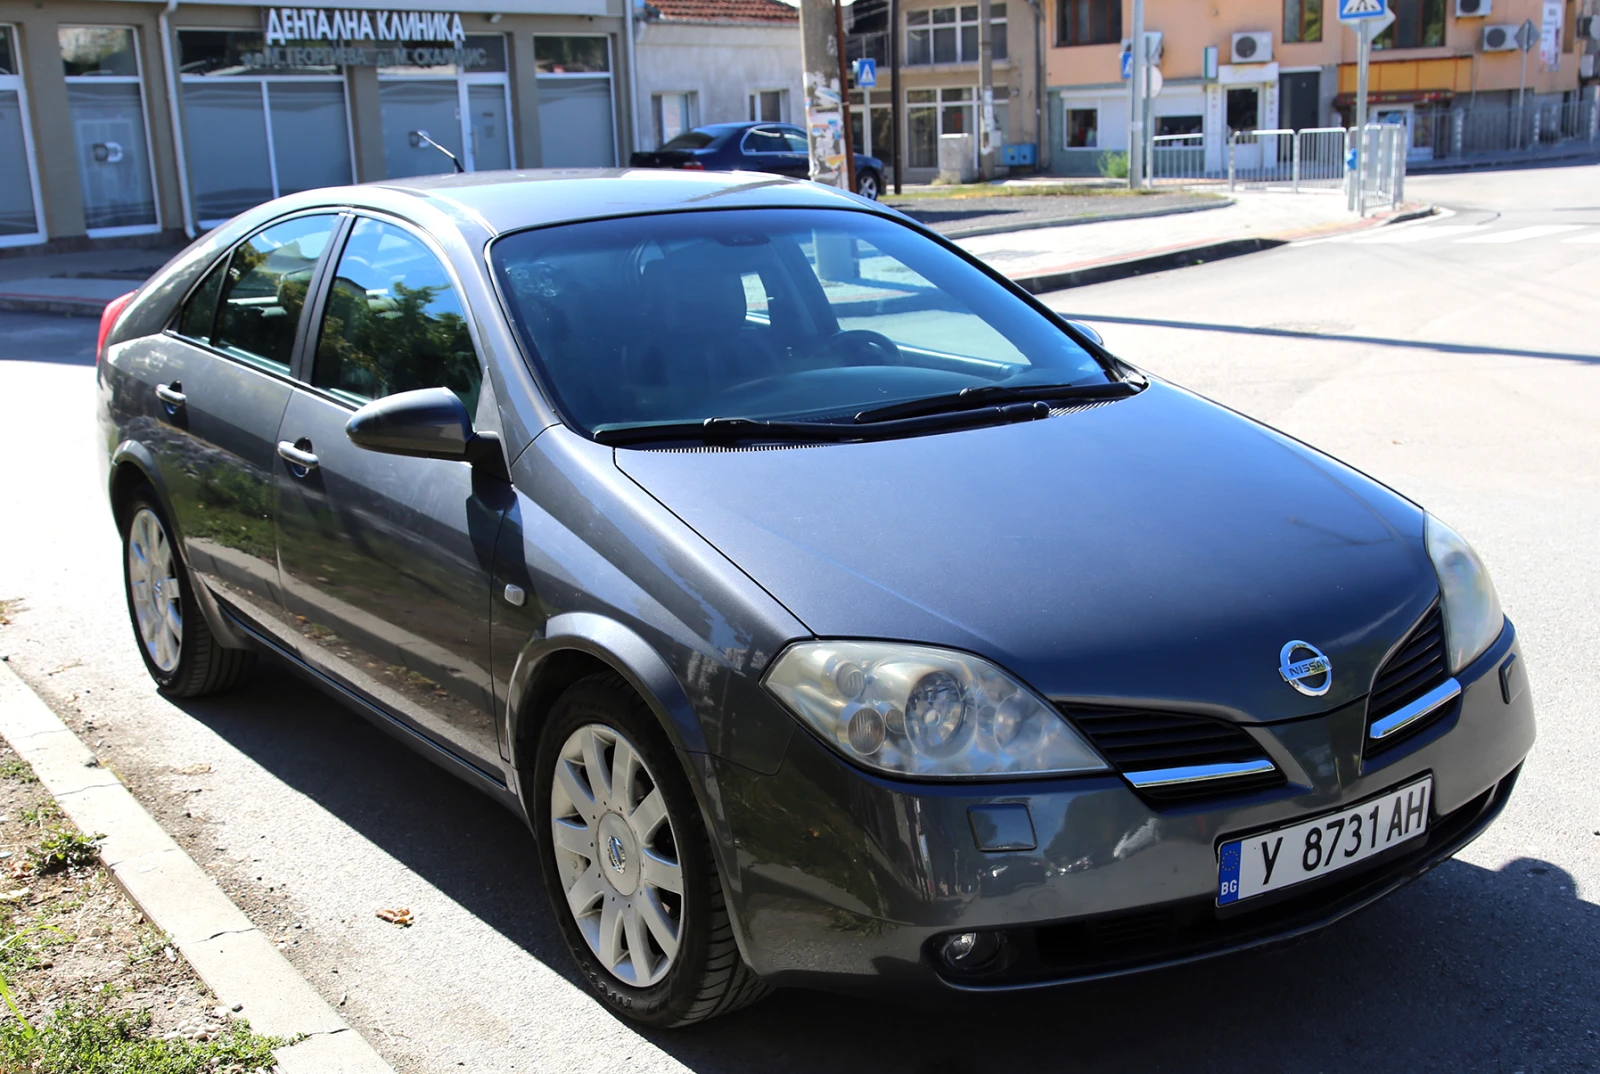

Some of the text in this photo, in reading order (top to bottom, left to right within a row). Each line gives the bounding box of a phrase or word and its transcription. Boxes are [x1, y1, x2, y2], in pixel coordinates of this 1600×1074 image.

[266, 8, 466, 45] ДЕНТАЛНА КЛИНИКА
[1288, 659, 1330, 676] NISSAN
[1302, 805, 1380, 872] 8731
[1220, 879, 1238, 896] BG
